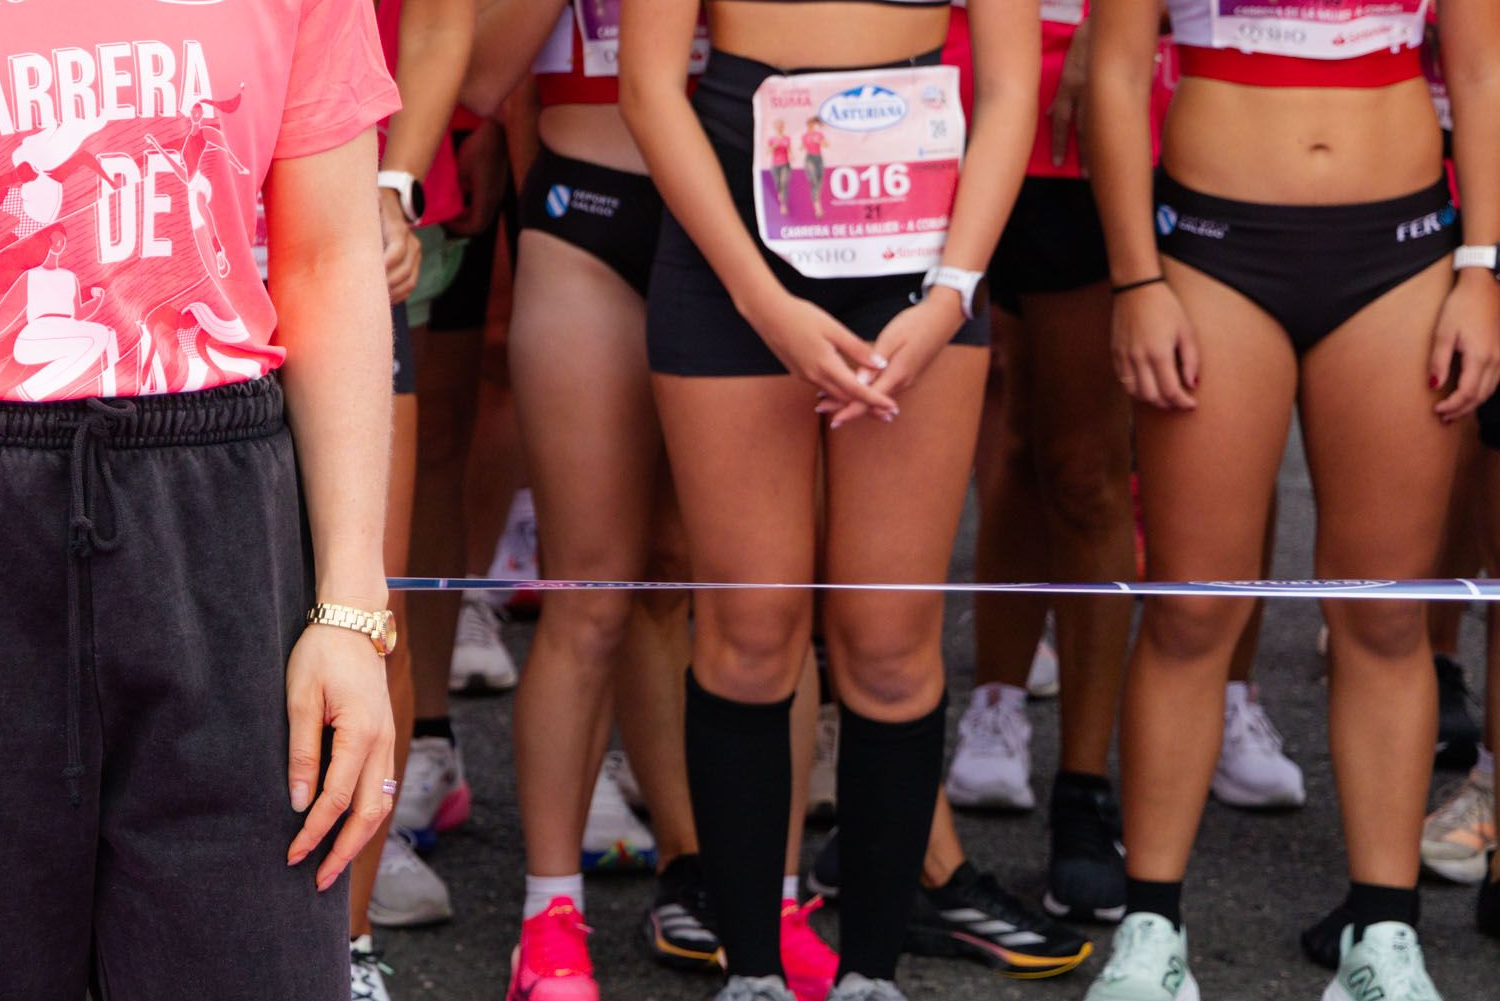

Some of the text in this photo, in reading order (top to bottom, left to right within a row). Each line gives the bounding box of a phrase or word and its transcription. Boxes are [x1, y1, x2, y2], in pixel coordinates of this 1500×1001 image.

[1301, 7, 1315, 19] LA
[828, 106, 902, 122] ASTURIANA
[830, 164, 911, 200] 016
[97, 149, 183, 264] DE
[573, 190, 619, 207] DEPORTE
[865, 206, 881, 218] 21
[780, 224, 829, 239] CARRERA
[832, 224, 846, 236] DE
[849, 223, 863, 235] LA
[866, 221, 899, 234] MUJER
